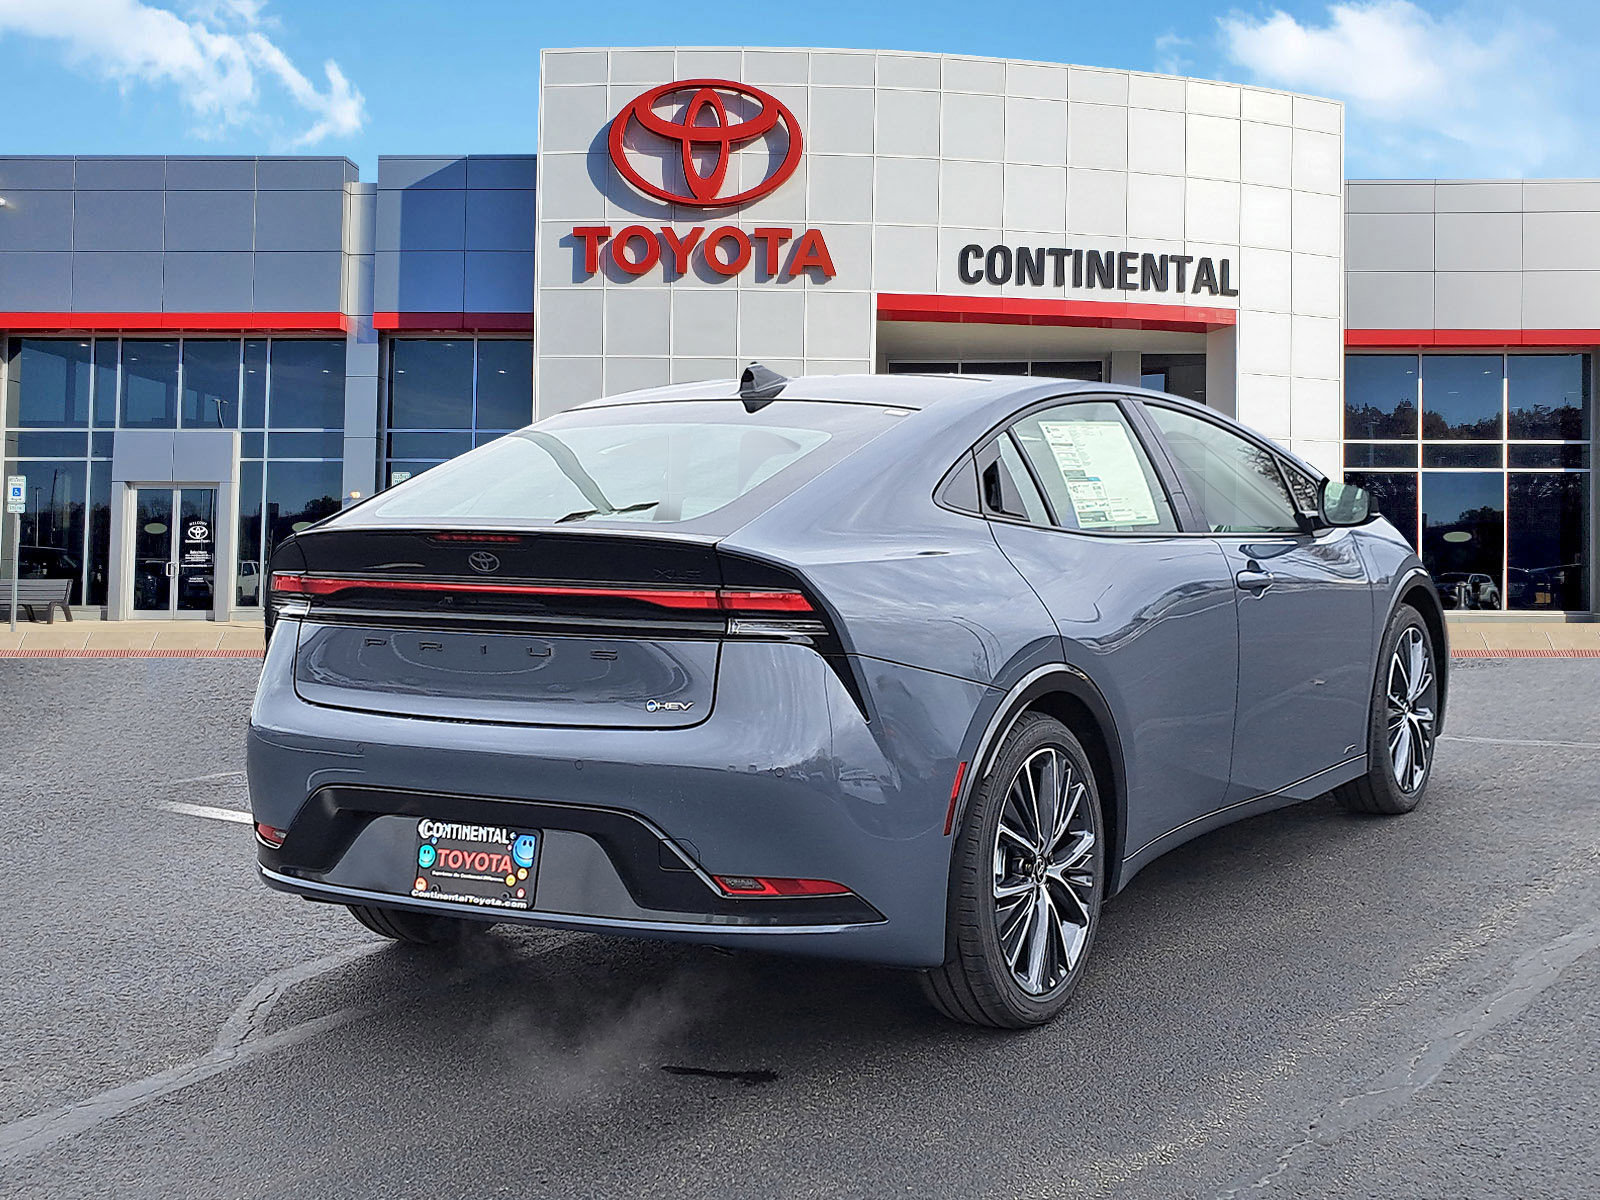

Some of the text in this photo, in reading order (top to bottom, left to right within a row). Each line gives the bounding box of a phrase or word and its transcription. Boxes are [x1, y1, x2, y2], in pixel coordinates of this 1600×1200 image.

[572, 225, 837, 277] TOYOTA
[959, 244, 1239, 296] CONTINENTAL
[363, 637, 618, 661] PRIUS
[418, 819, 510, 844] CONTINENTAL
[437, 849, 513, 873] TOYOTA
[411, 890, 527, 909] ContinentalToyota.com
